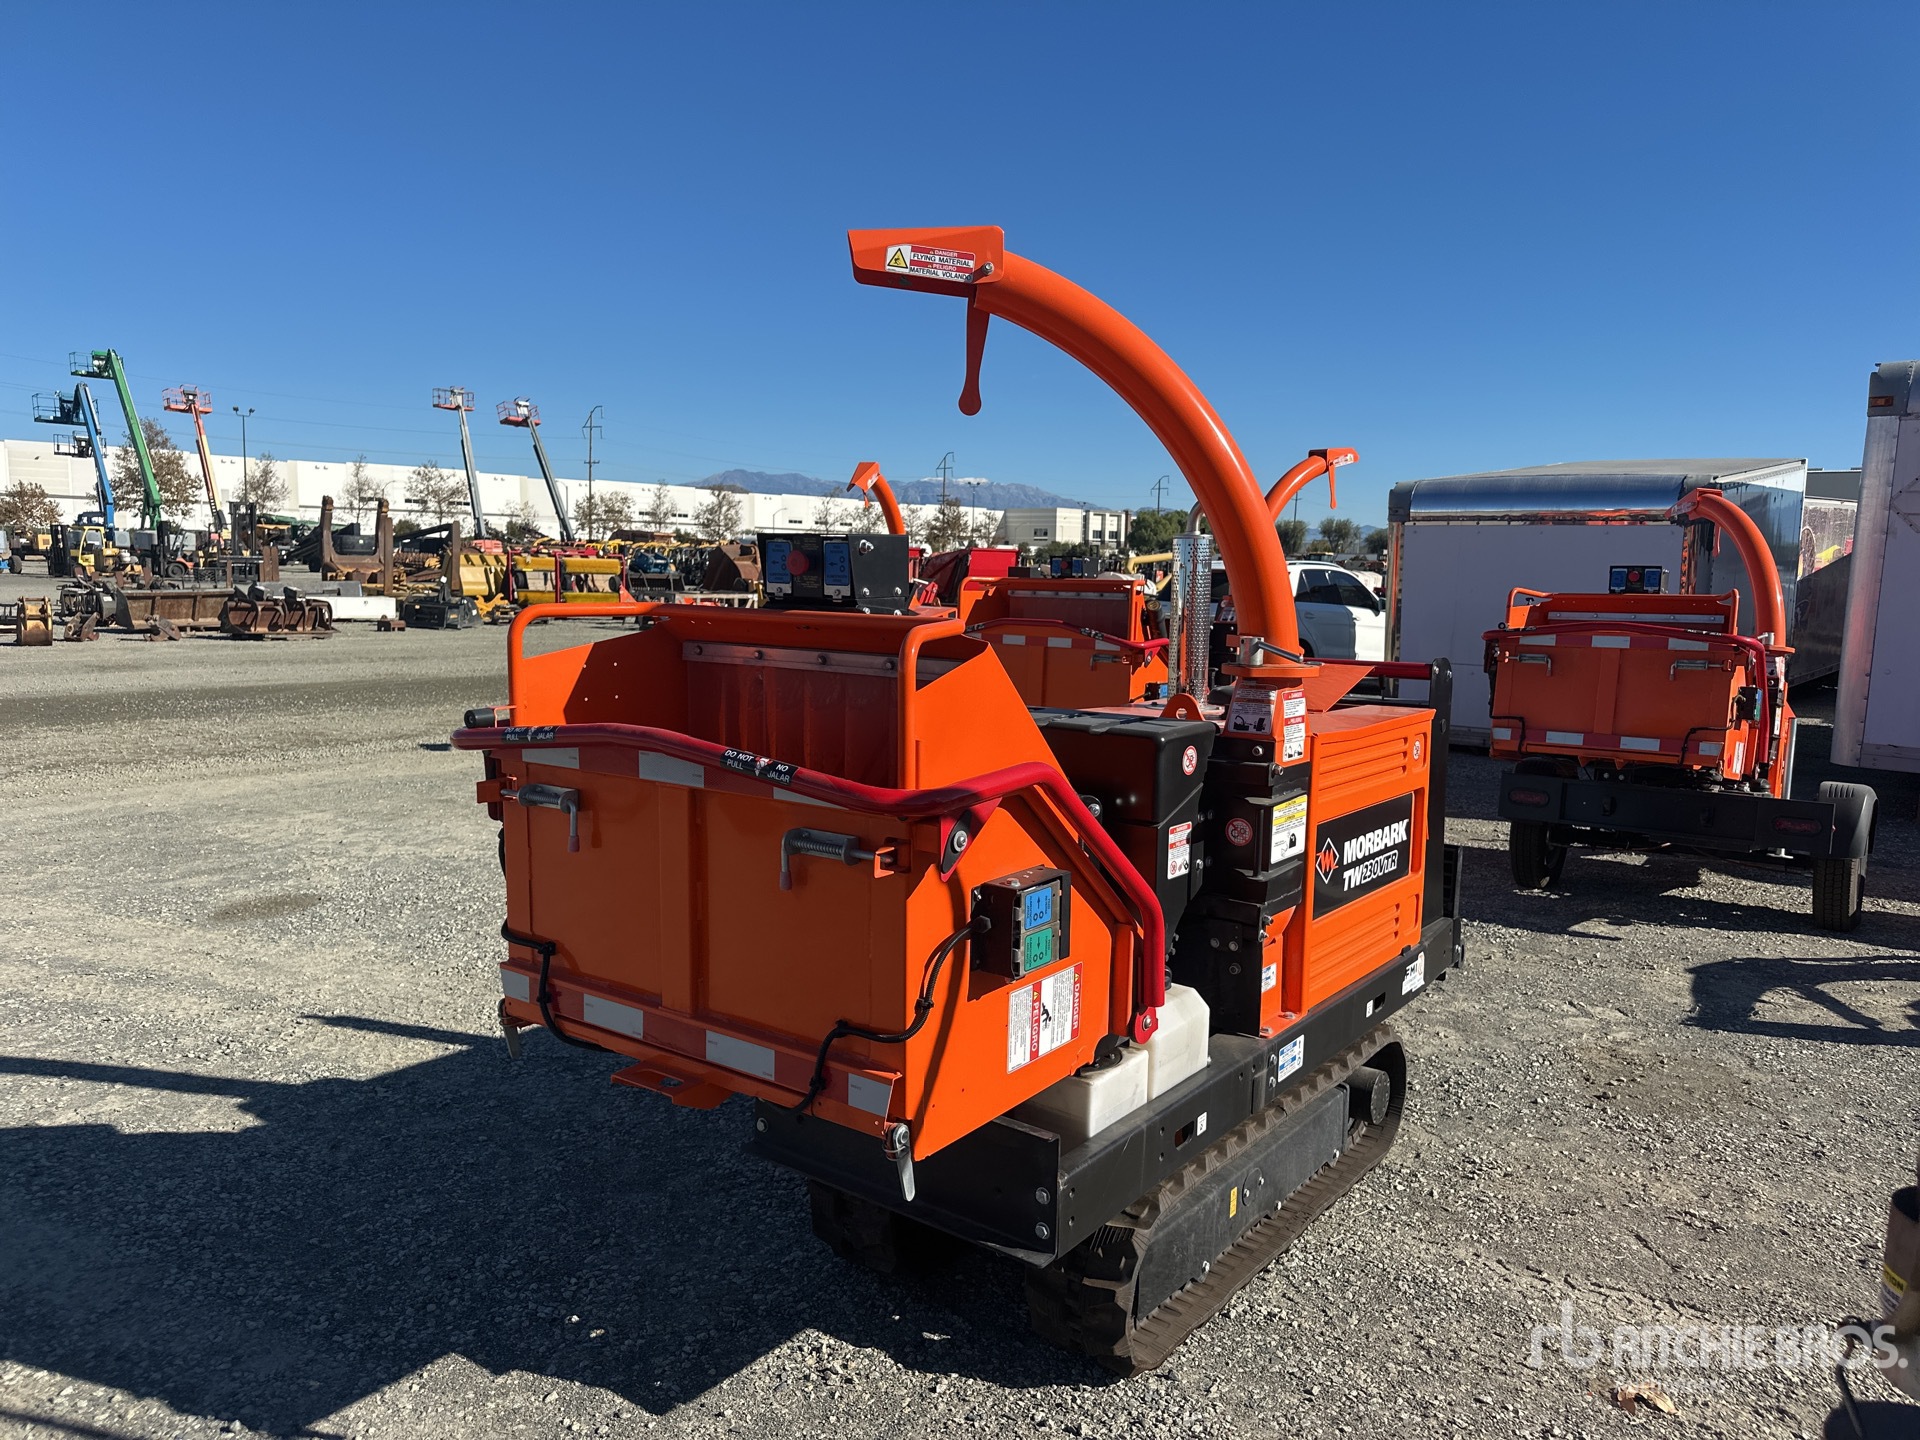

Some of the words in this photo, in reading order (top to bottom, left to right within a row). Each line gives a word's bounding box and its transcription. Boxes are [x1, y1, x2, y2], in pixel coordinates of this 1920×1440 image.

[912, 253, 936, 262] FLYING
[938, 256, 971, 267] MATERIAL
[934, 250, 958, 258] DANGER
[910, 266, 940, 277] MATERIAL
[941, 271, 972, 281] VOLANDO
[932, 263, 957, 272] PELIGRO
[506, 733, 519, 741] PULL
[536, 732, 554, 740] JALAR
[724, 749, 737, 758] DO
[737, 753, 755, 762] NOT
[726, 758, 744, 770] PULL
[775, 764, 789, 772] NO
[767, 770, 790, 783] JALAR
[1343, 818, 1409, 866] MORBARK
[1072, 983, 1080, 1030] DANGER
[1031, 1001, 1040, 1052] PELIGRO
